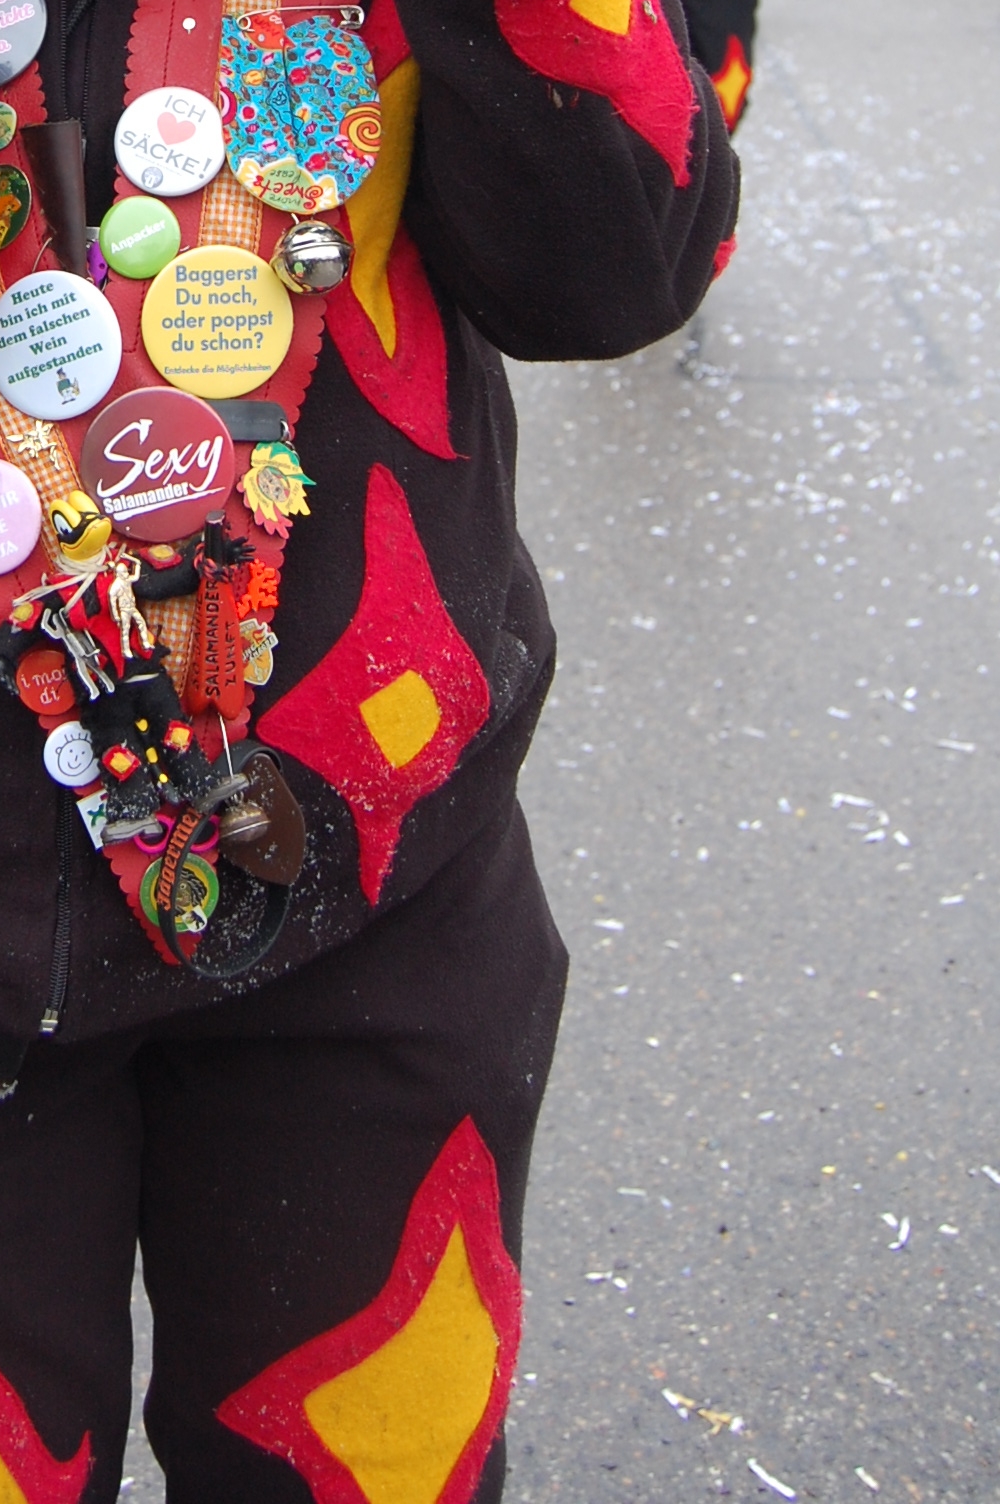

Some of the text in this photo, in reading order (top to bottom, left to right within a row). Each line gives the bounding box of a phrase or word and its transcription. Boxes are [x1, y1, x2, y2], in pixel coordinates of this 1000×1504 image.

[164, 94, 206, 123] ICH
[119, 130, 212, 180] SÄCKE!
[111, 218, 166, 255] Anpacker
[175, 265, 258, 287] Baggerst
[11, 282, 54, 306] Heute
[175, 284, 257, 306] Du noch,
[0, 291, 77, 329] bin ich mit
[28, 307, 91, 338] falschen
[161, 309, 273, 332] oder poppst
[29, 335, 68, 356] Wein
[171, 331, 264, 352] du schon?
[8, 341, 104, 385] aufgestanden
[164, 362, 272, 375] Entdecke die Möglichkeiten
[96, 418, 224, 498] Sexy
[103, 481, 189, 514] Salamander
[205, 579, 220, 697] SALAMANDER
[39, 686, 60, 705] di
